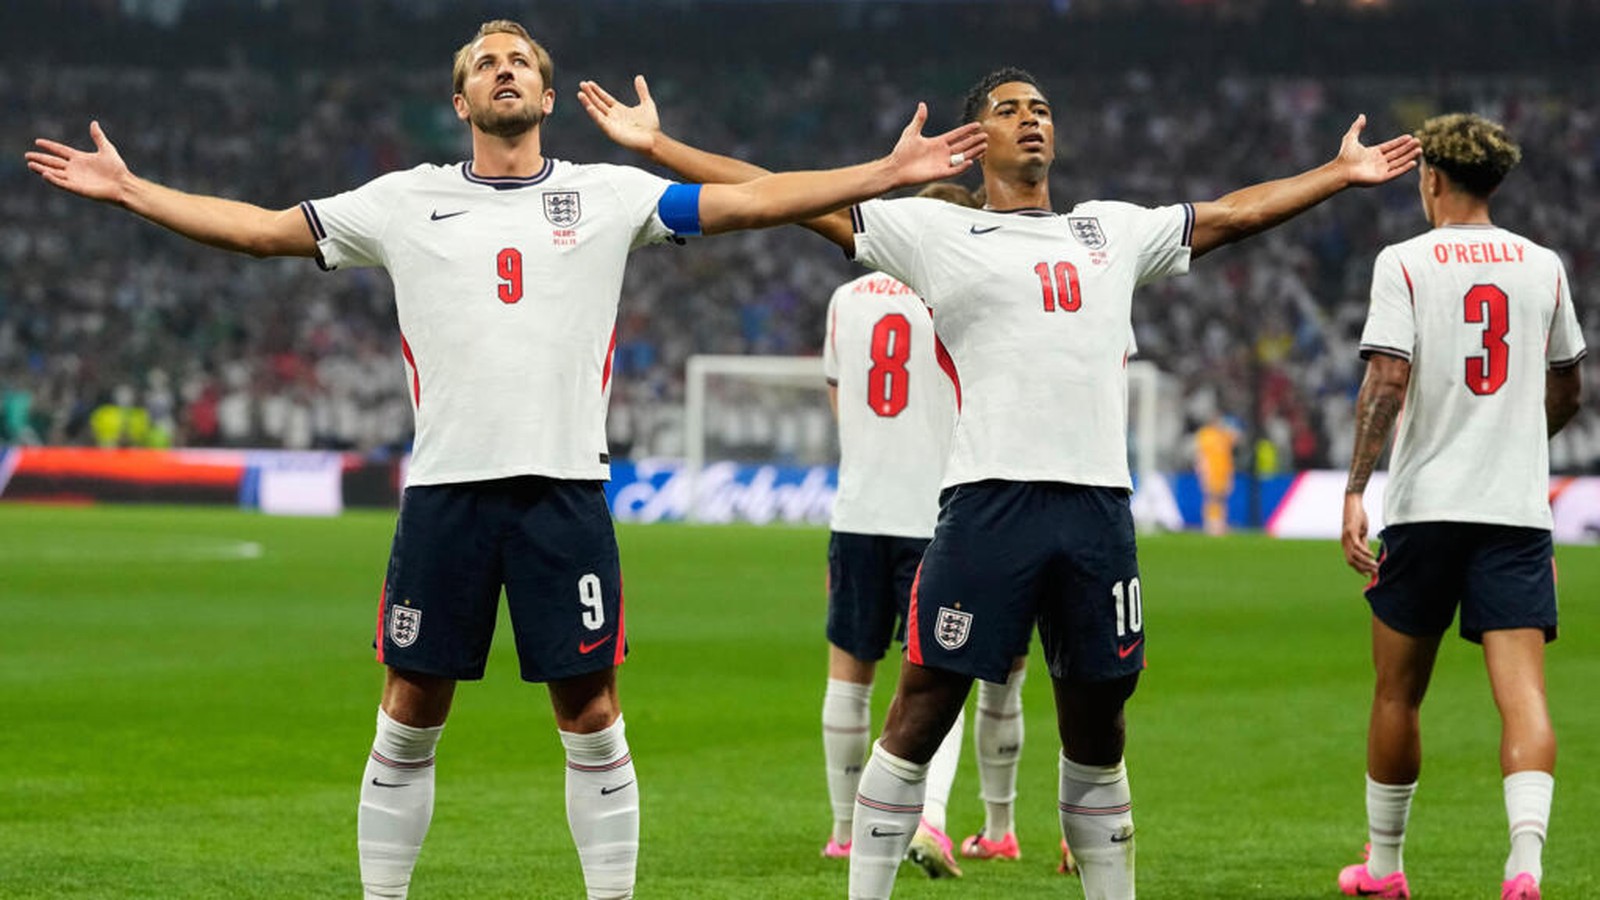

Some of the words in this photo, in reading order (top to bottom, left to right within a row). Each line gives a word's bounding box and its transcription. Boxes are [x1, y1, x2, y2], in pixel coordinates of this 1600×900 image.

[497, 247, 523, 304] 9
[1434, 243, 1525, 264] O'REILLY
[1034, 261, 1082, 313] 10
[867, 313, 911, 418] 8
[1464, 283, 1510, 396] 3
[578, 573, 605, 630] 9
[1112, 577, 1142, 636] 10
